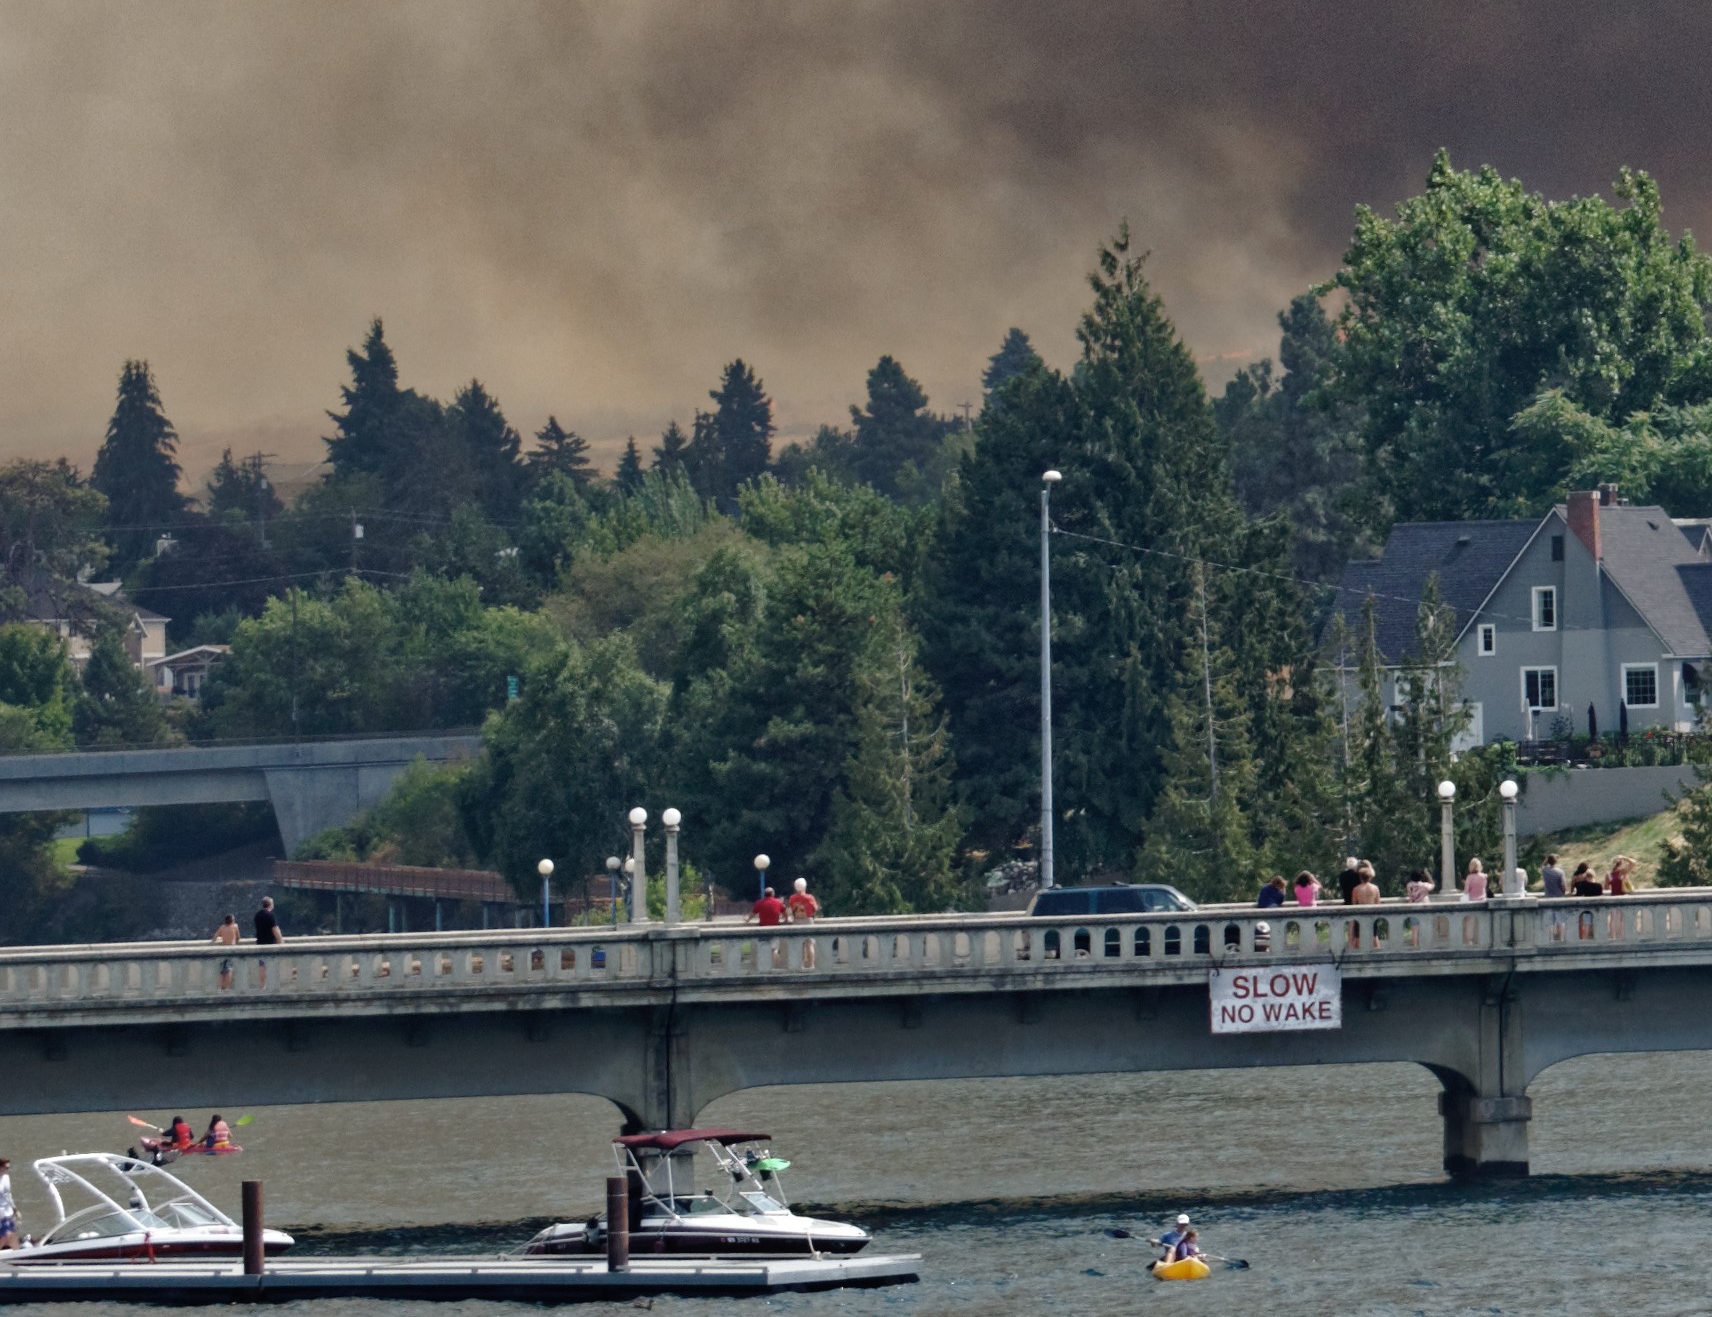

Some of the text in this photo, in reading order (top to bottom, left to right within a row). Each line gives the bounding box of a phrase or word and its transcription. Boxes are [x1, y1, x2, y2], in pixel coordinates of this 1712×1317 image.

[1232, 972, 1318, 999] SLOW
[1221, 1001, 1332, 1023] NO WAKE
